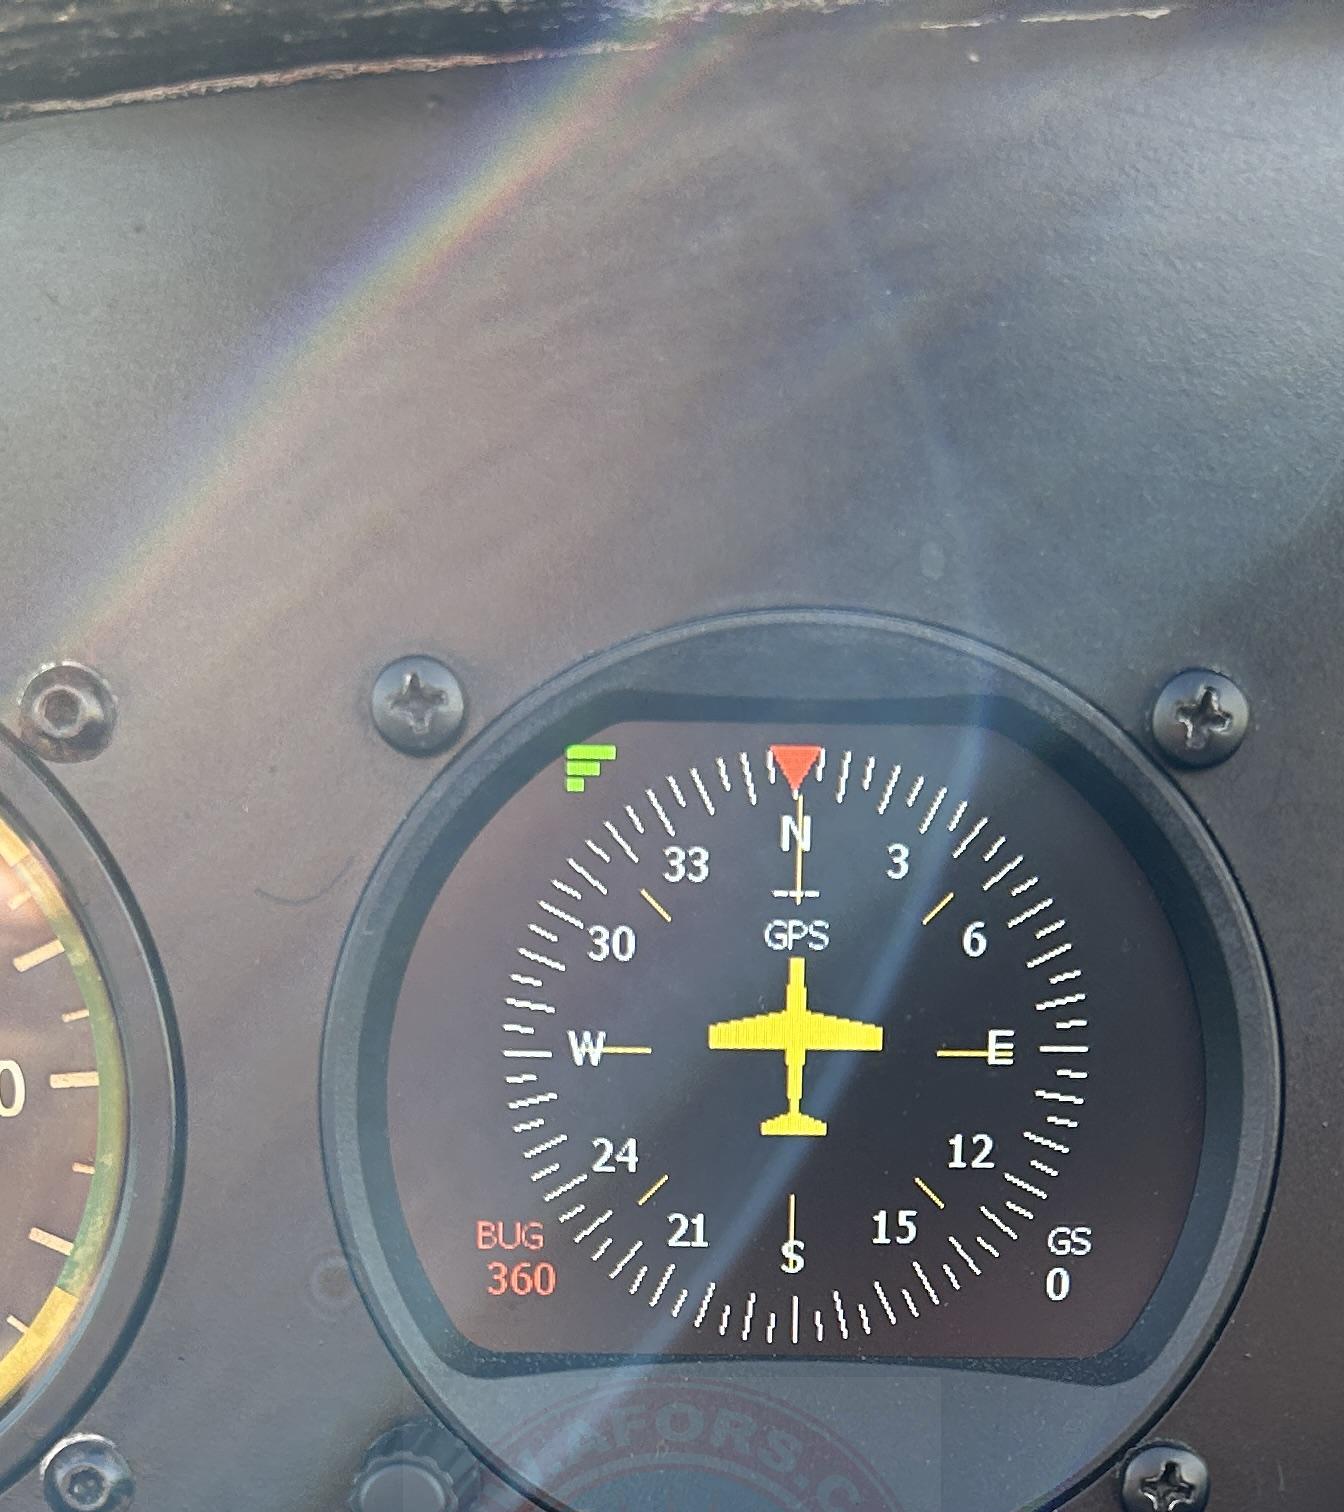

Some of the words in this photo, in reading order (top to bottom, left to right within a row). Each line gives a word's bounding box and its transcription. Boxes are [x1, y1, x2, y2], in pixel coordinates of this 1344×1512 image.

[780, 816, 811, 853] N
[662, 847, 711, 883] 33
[886, 845, 910, 879] 3
[587, 926, 637, 961] 30
[763, 921, 830, 952] GPS
[963, 923, 987, 958] 6
[568, 1031, 606, 1067] W
[987, 1031, 1015, 1066] E
[591, 1139, 639, 1173] 24
[947, 1136, 995, 1170] 12
[476, 1220, 544, 1252] BUG
[667, 1215, 709, 1248] 21
[871, 1211, 917, 1245] 15
[1047, 1227, 1092, 1258] GS
[781, 1239, 805, 1274] S
[487, 1262, 556, 1296] 360
[1046, 1268, 1069, 1301] 0
